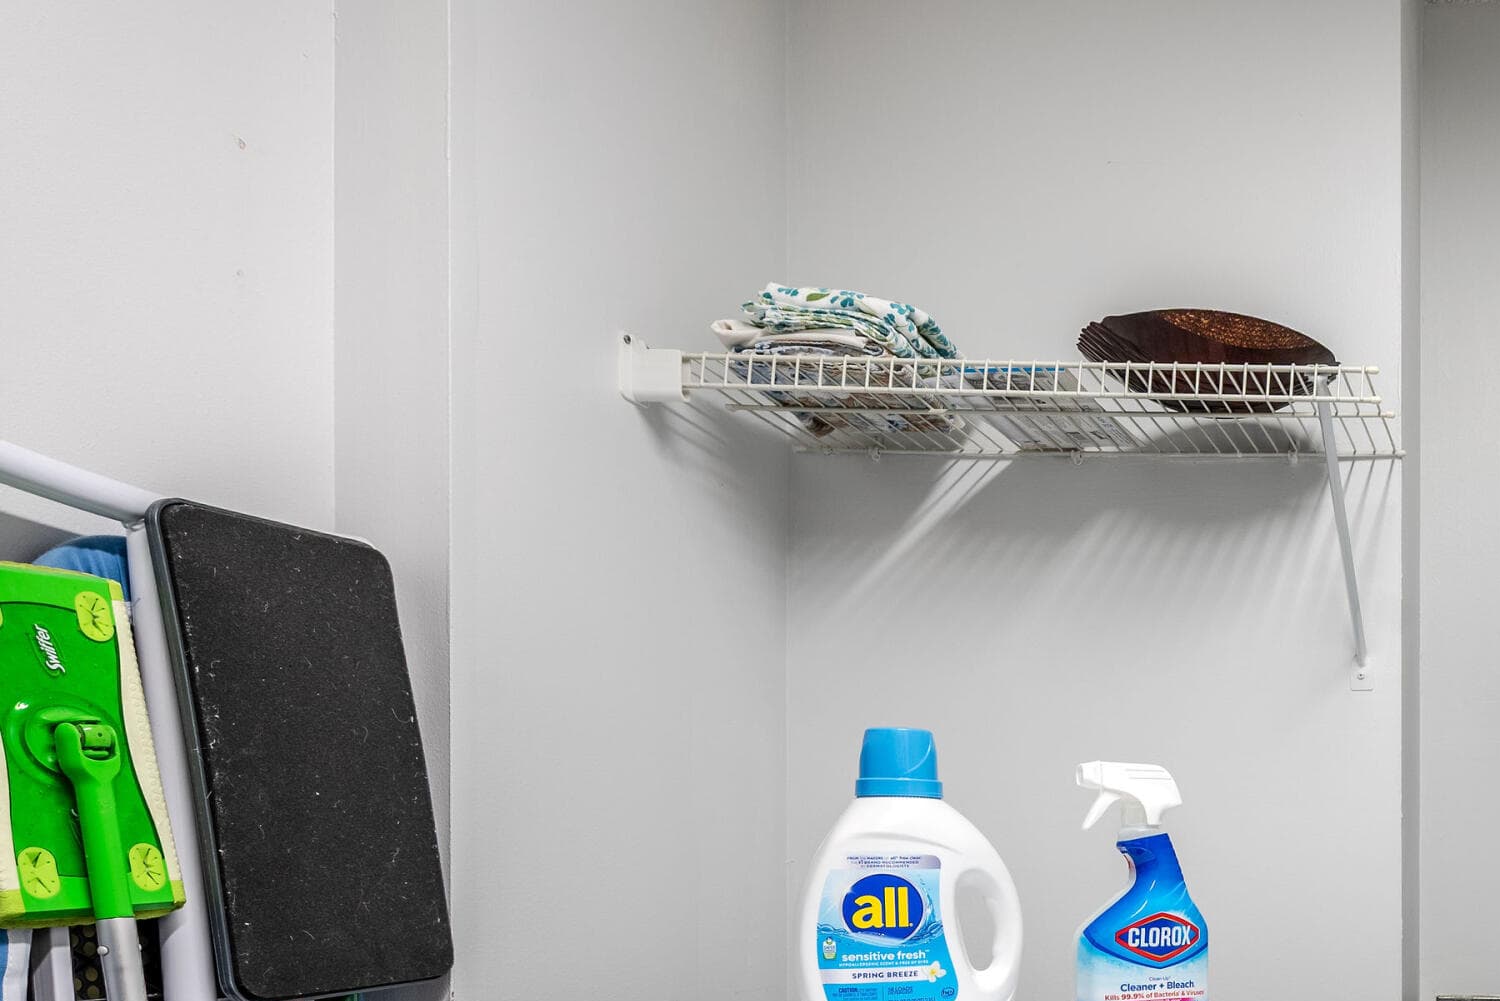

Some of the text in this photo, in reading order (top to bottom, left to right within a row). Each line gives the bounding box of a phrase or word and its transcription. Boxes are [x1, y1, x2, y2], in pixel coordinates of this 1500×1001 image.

[34, 623, 66, 673] Swiffer
[852, 886, 910, 929] all
[1127, 925, 1191, 948] CLOROX
[842, 949, 926, 962] sensitive fresh
[851, 970, 919, 980] SPRING BREEZE
[1120, 983, 1157, 992] Cleaner
[1167, 980, 1195, 990] Bleach
[1121, 993, 1145, 1001] 99.9%
